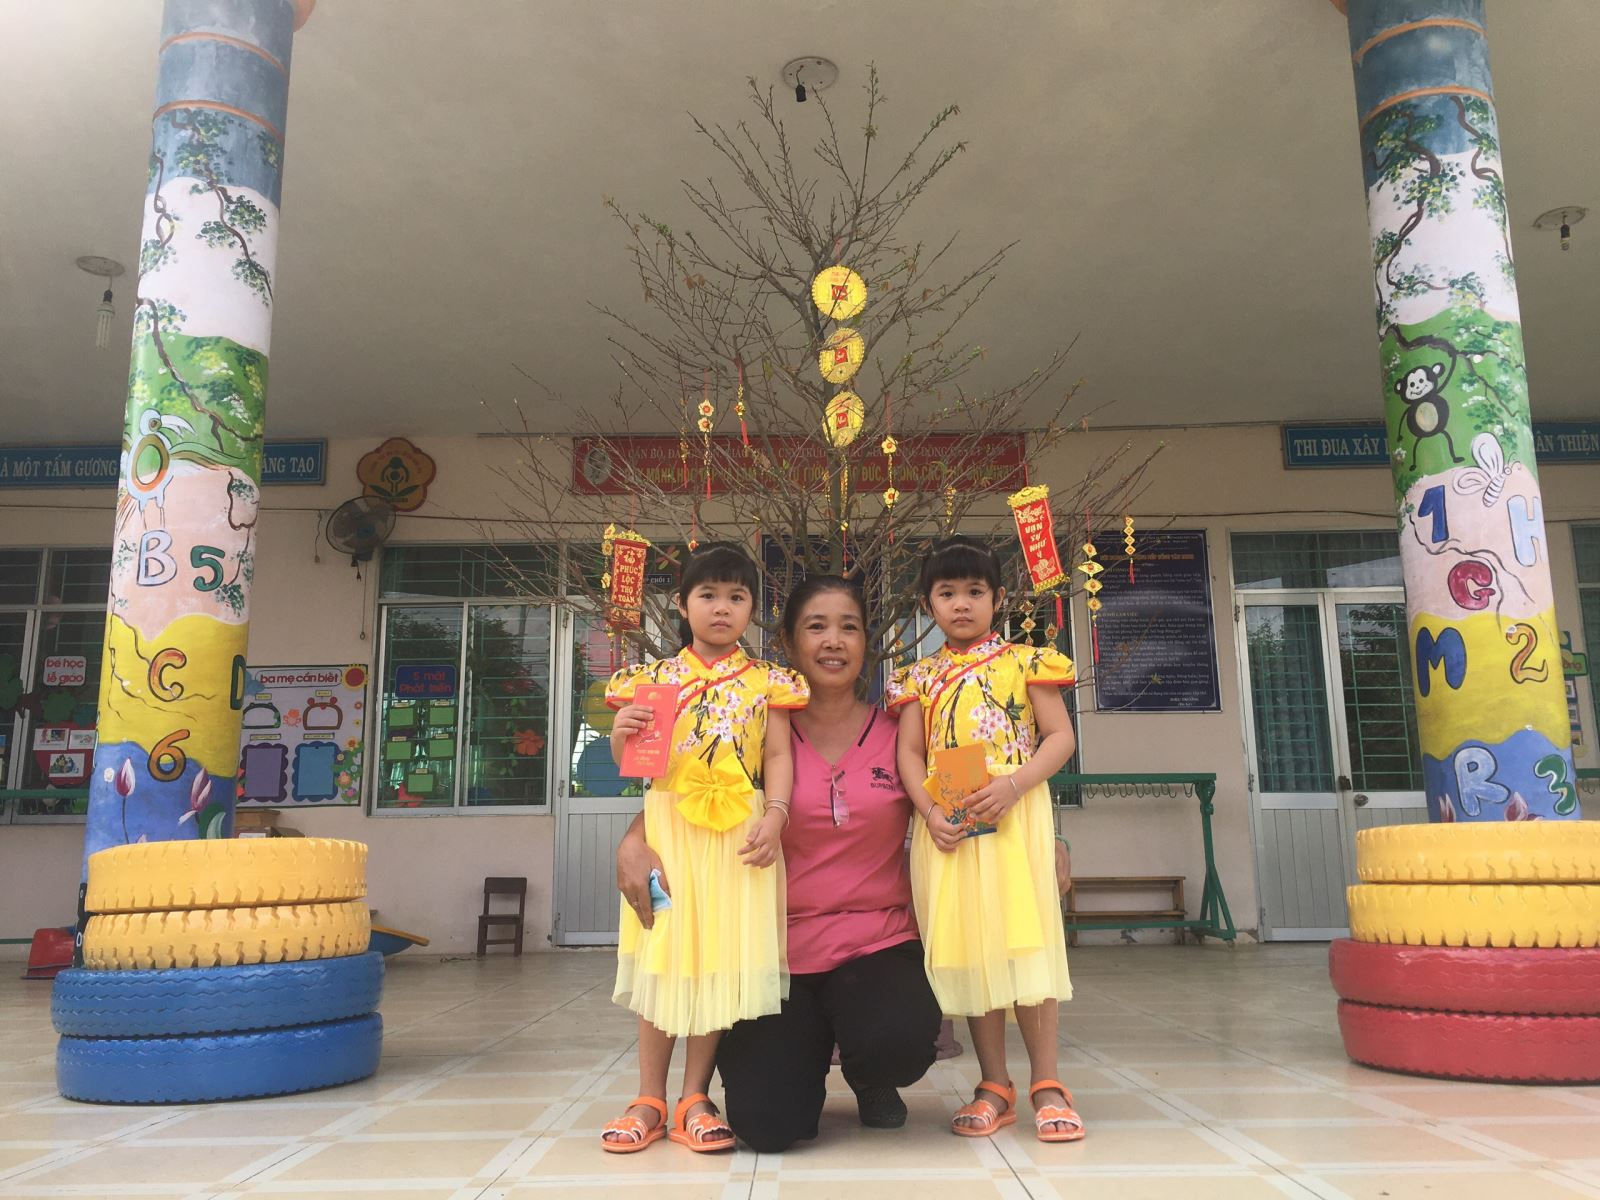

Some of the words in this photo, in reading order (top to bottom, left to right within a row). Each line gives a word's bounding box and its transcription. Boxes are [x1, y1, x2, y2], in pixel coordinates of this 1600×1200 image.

[1294, 439, 1318, 456] THI
[1321, 439, 1350, 456] ĐUA
[1352, 433, 1380, 455] XÂY
[1556, 430, 1600, 455] THIỆN
[13, 456, 40, 480] MỘT
[44, 453, 72, 477] TẤM
[75, 456, 117, 477] GƯƠNG
[289, 456, 314, 477] TẠO
[1417, 485, 1449, 544] 1
[137, 529, 177, 587] B
[190, 545, 225, 592] 5
[620, 563, 639, 574] PHÚC
[621, 573, 635, 585] LỘC
[620, 585, 633, 595] THỌ
[1447, 560, 1496, 610] G
[63, 658, 84, 670] học
[148, 648, 187, 702] C
[1416, 626, 1467, 697] M
[1505, 623, 1548, 684] 2
[260, 674, 275, 684] ba
[277, 675, 295, 685] mẹ
[147, 729, 190, 782] 6
[1454, 746, 1511, 817] R
[1534, 754, 1577, 815] 3
